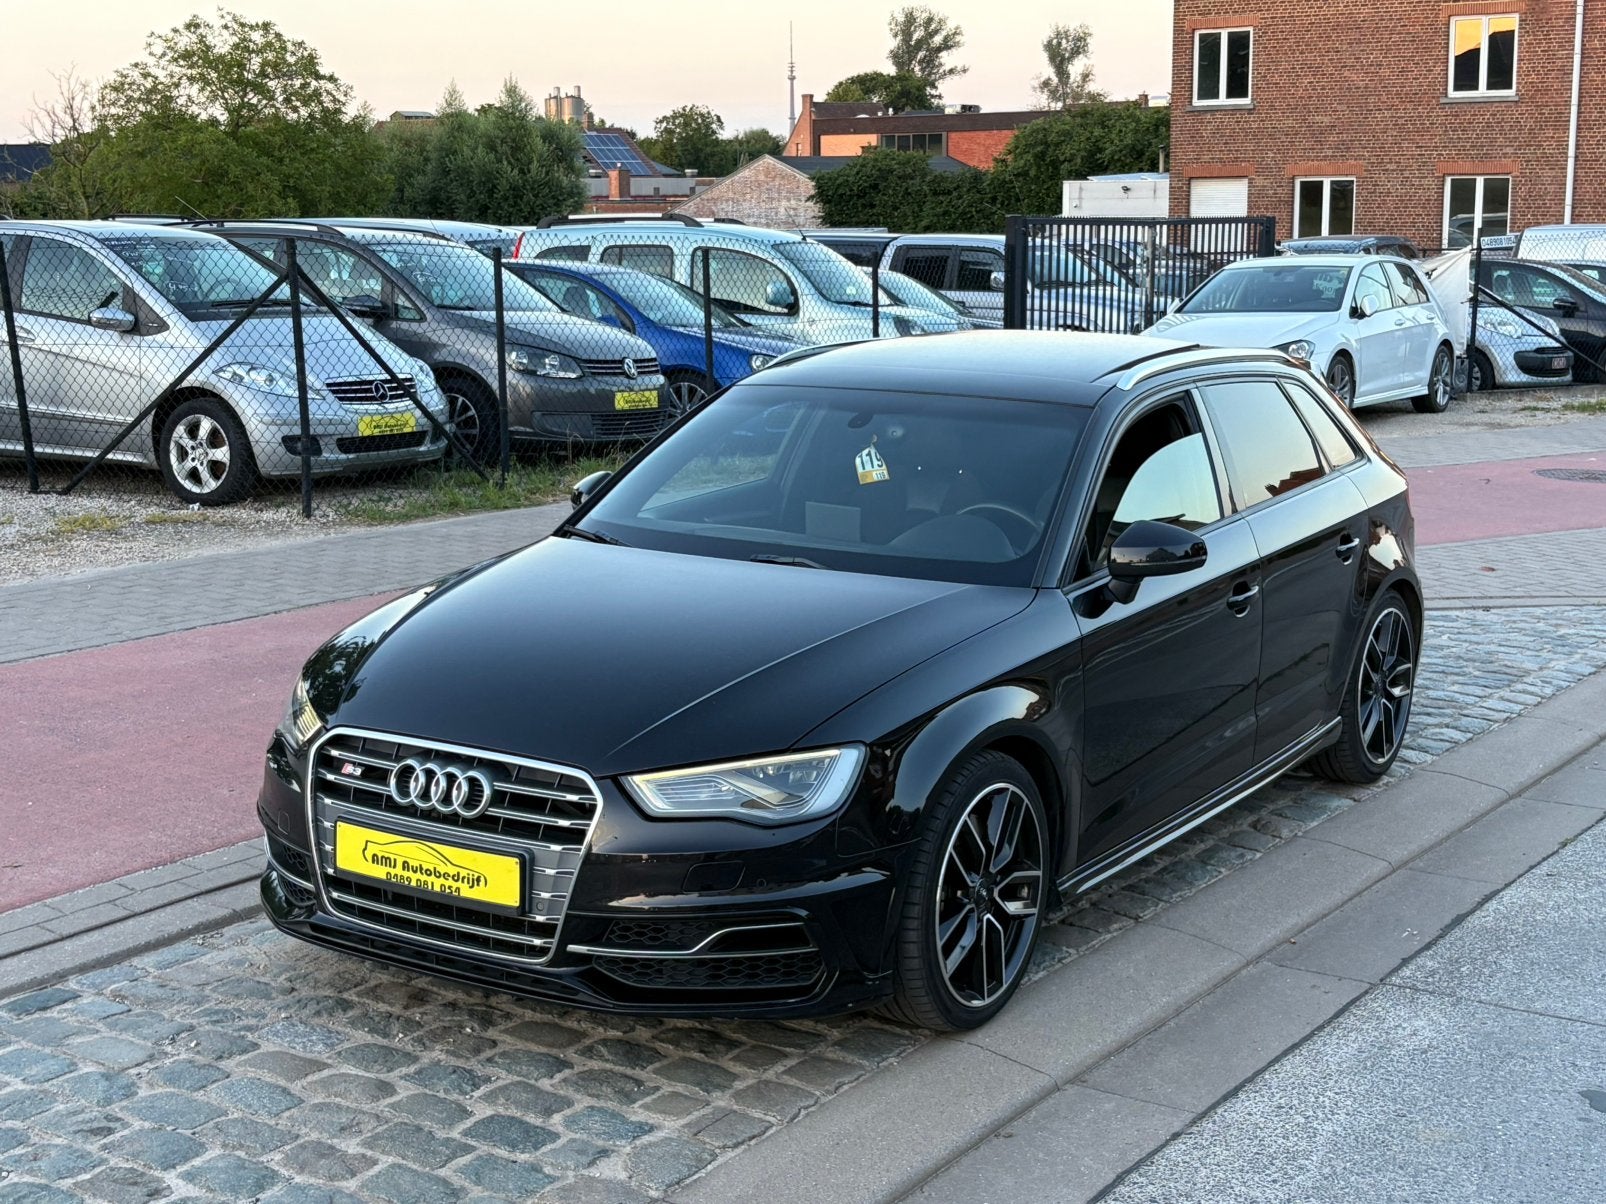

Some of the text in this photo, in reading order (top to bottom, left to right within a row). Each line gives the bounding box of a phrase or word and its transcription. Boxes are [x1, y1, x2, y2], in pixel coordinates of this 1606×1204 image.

[371, 853, 482, 890] AMJ Autobedrijf
[386, 871, 461, 897] 0489 081 054
